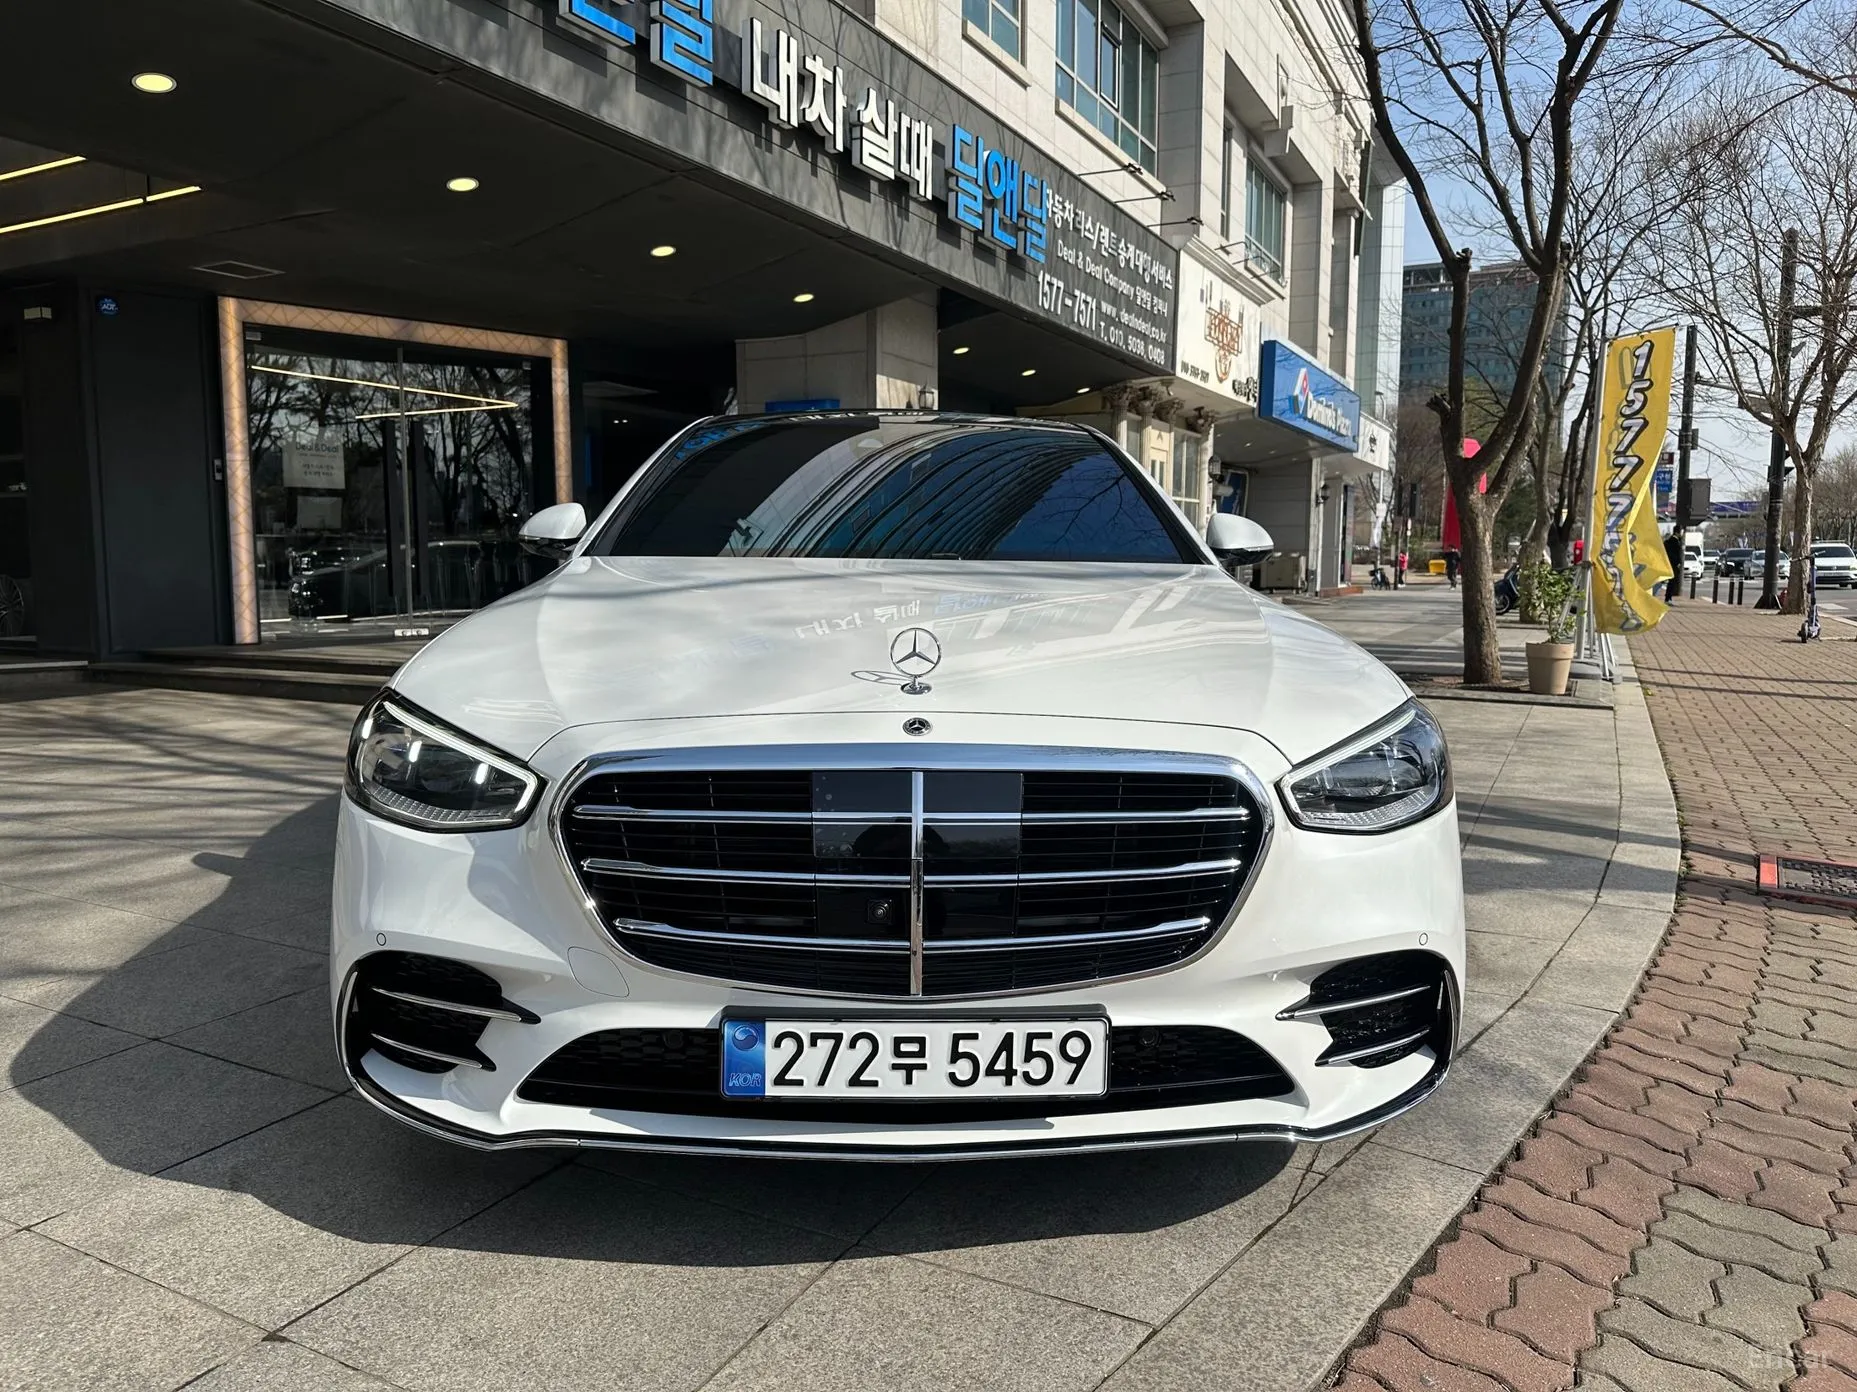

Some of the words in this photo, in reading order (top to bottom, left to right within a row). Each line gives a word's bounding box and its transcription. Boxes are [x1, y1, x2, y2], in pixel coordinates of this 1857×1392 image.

[749, 17, 847, 153] 내차
[858, 88, 932, 200] 살때
[953, 123, 1047, 264] 딜앤딜
[1057, 239, 1076, 264] Deal
[1077, 251, 1084, 269] &
[1085, 256, 1102, 280] Deal
[1103, 267, 1135, 300] Company
[728, 1071, 762, 1088] KOR
[773, 1030, 928, 1088] 272무
[949, 1030, 1093, 1088] 5459
